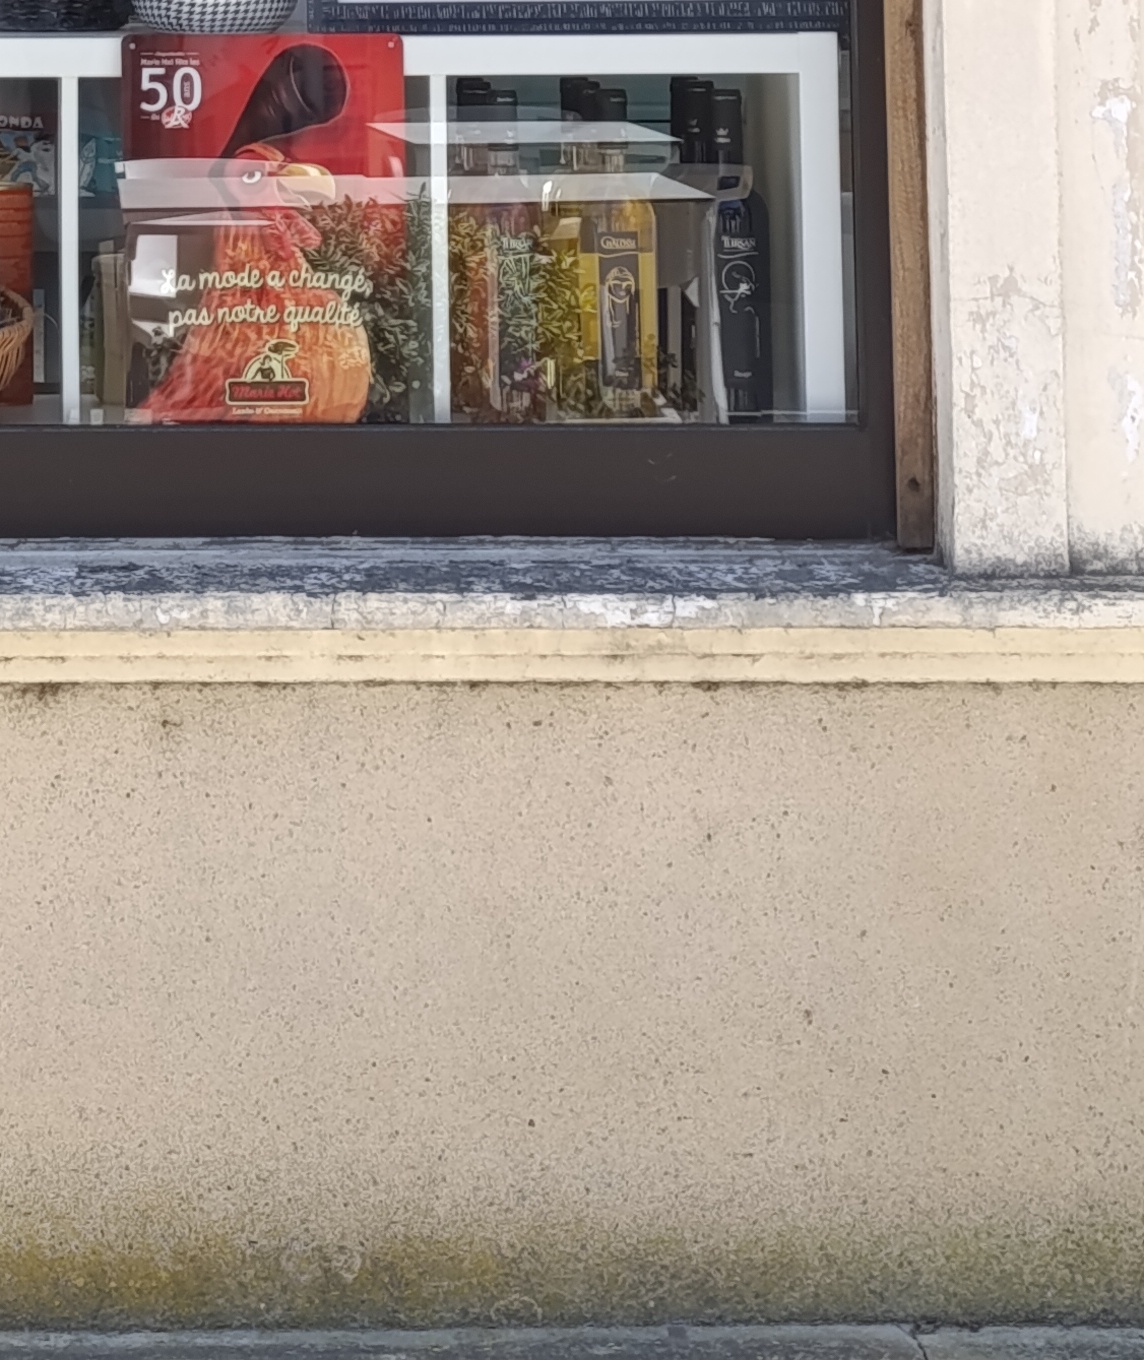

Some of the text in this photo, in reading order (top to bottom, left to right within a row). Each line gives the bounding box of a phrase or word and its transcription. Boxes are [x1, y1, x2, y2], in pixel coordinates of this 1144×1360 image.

[139, 66, 202, 113] 50
[159, 267, 197, 296] La
[198, 262, 263, 290] mode
[167, 300, 363, 338] pas notre qualité
